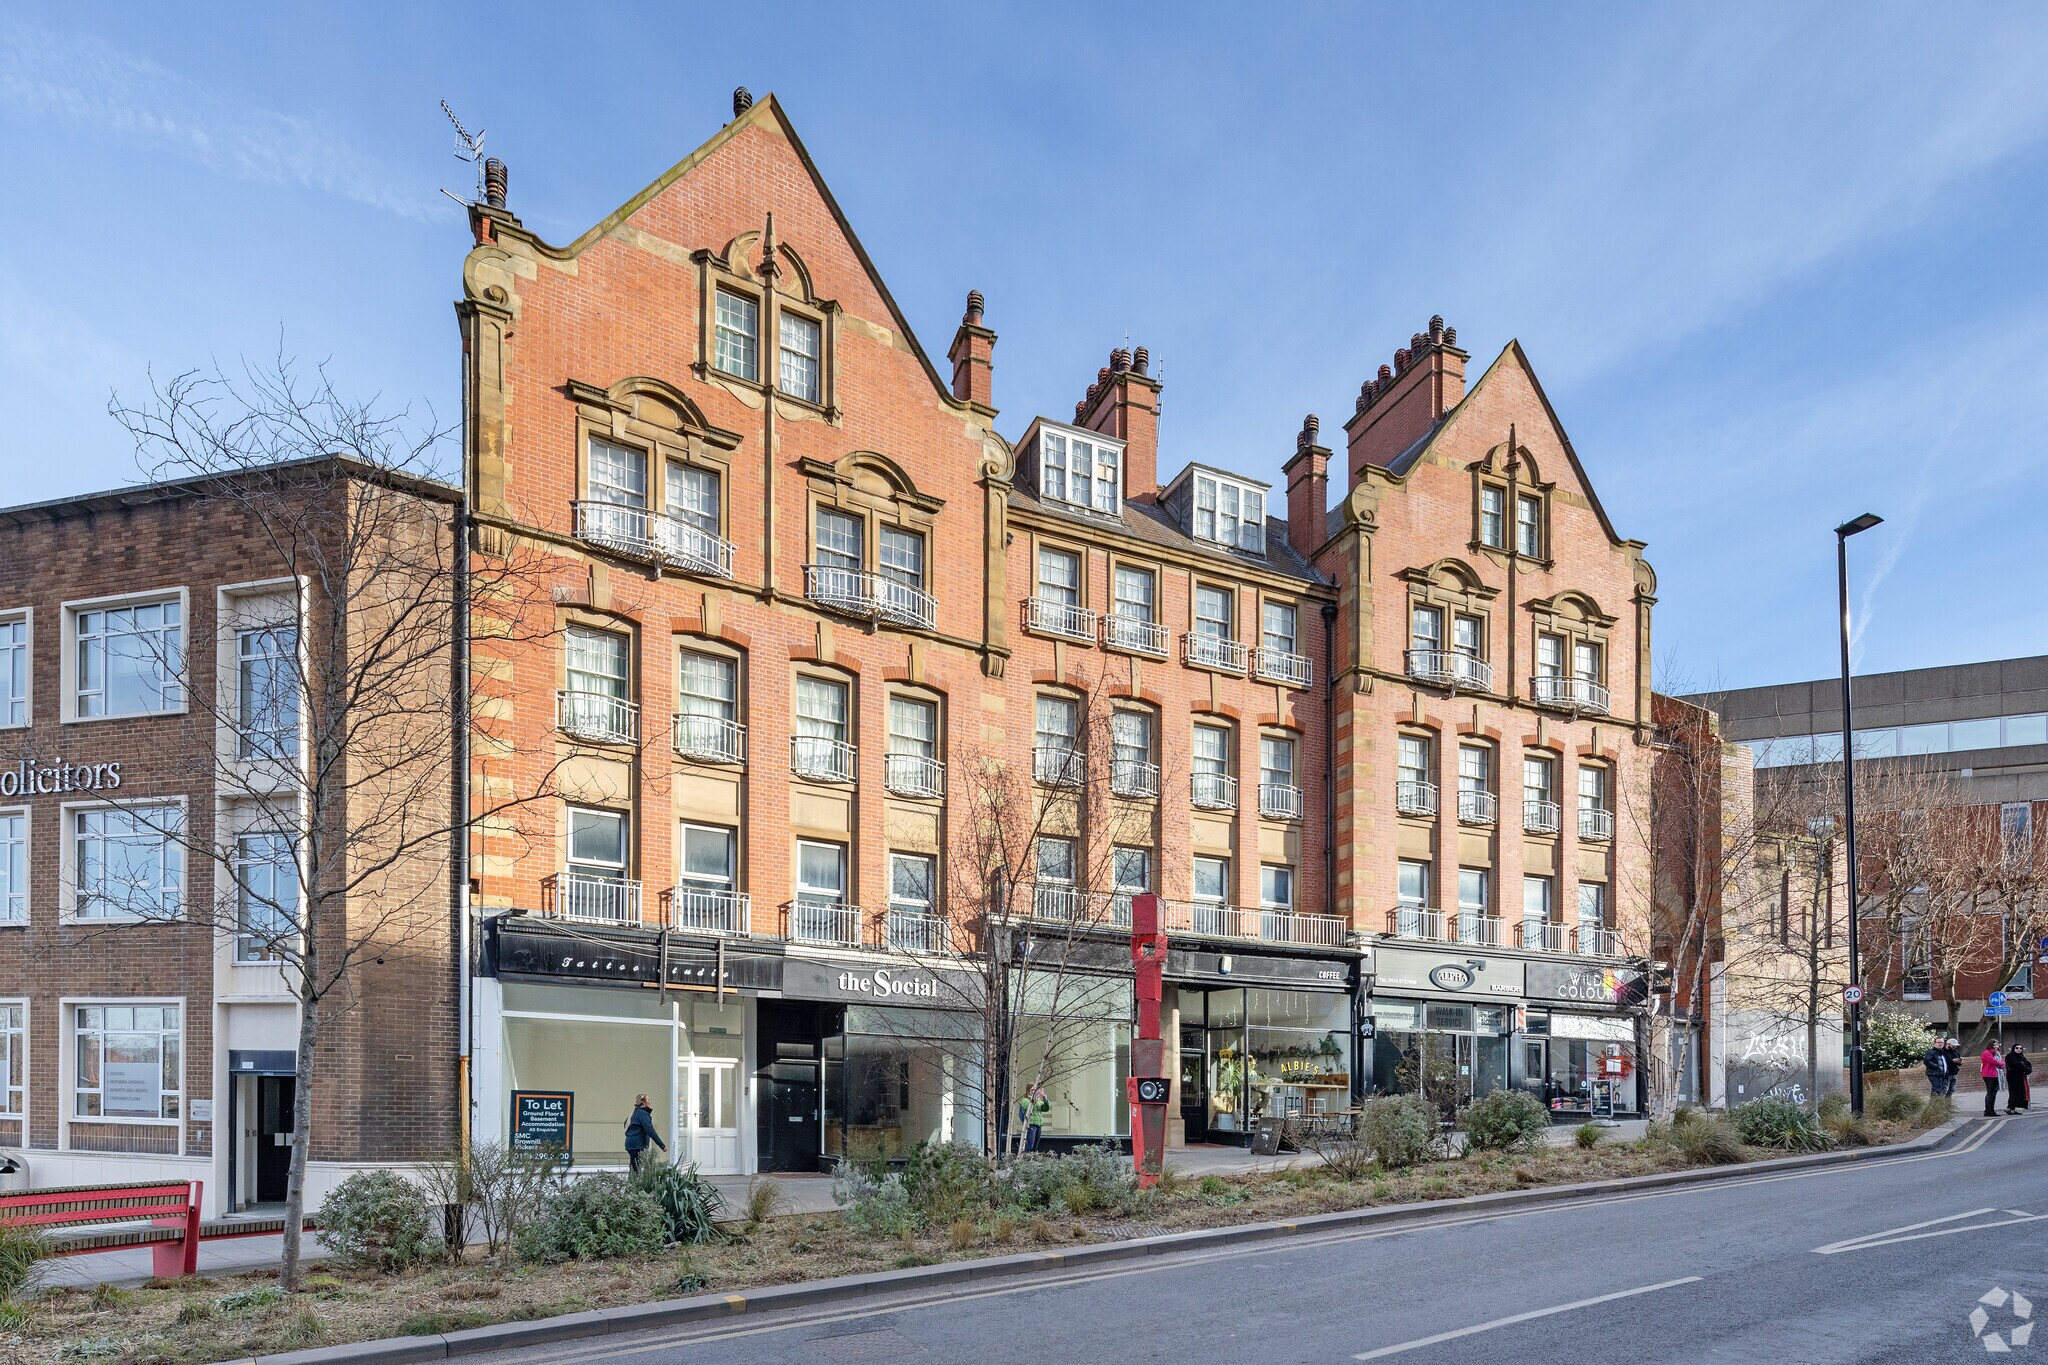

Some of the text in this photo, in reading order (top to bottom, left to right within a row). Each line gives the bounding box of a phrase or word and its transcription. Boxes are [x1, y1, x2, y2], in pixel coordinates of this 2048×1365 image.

[562, 957, 639, 972] Tattoo
[654, 965, 729, 978] tudio
[1318, 970, 1340, 980] COFFEE
[1437, 970, 1468, 983] ALPHA
[1569, 970, 1603, 987] WILD
[837, 970, 938, 997] the Social
[1490, 984, 1523, 993] BARBERS
[1846, 990, 1860, 999] 20
[1435, 1006, 1463, 1016] WALK-IN
[1436, 1017, 1462, 1027] SERVICE
[707, 1041, 728, 1056] 28
[1280, 1060, 1319, 1076] ALBIE'S
[525, 1099, 563, 1110] To Let
